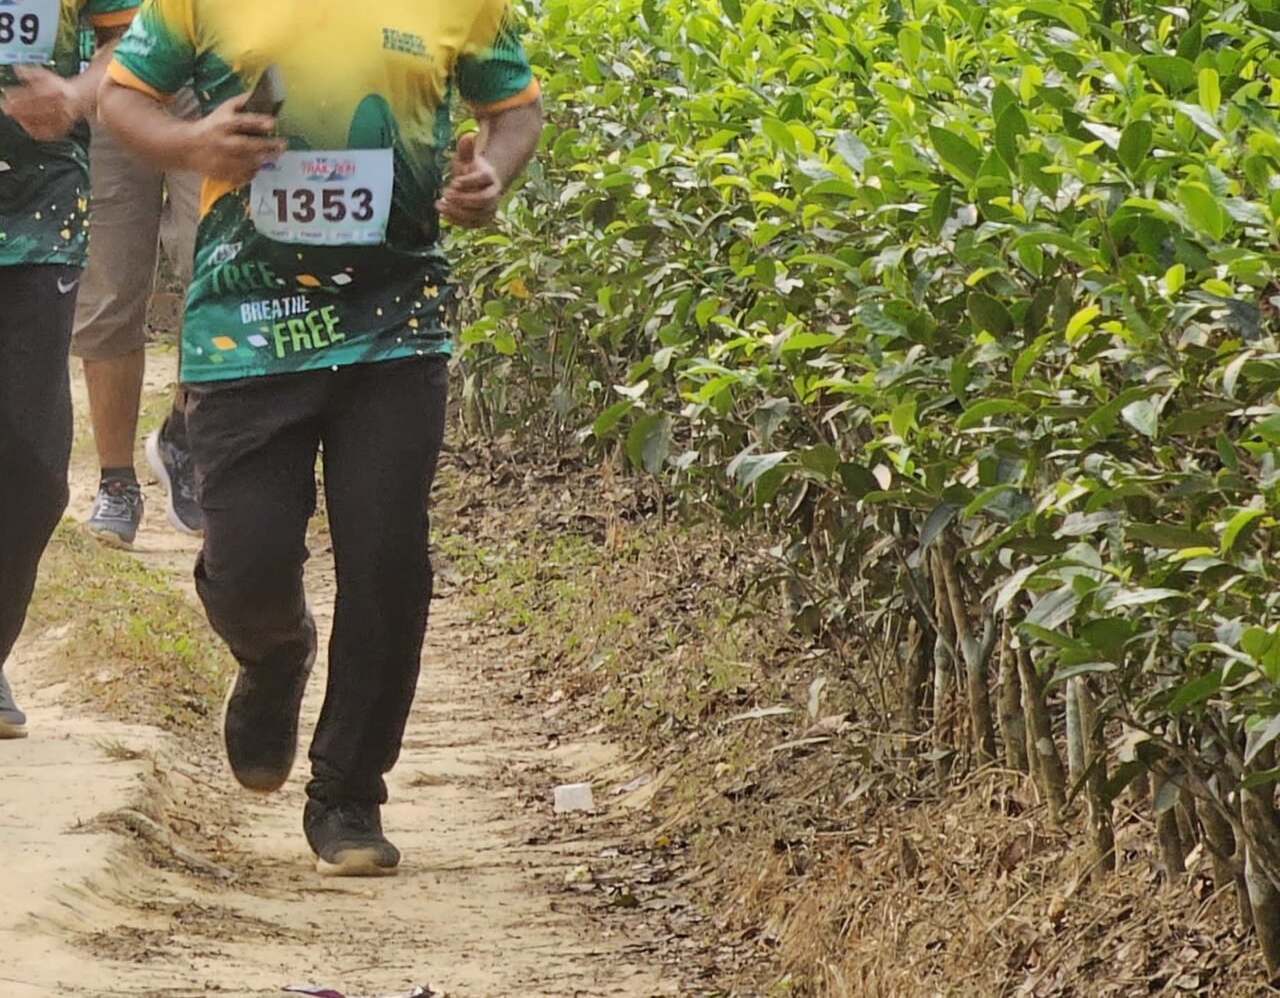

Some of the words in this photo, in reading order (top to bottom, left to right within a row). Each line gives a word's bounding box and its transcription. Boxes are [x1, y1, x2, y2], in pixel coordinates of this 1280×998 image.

[272, 188, 374, 224] 1353
[239, 295, 311, 325] BREATHE
[273, 305, 346, 359] FREE
